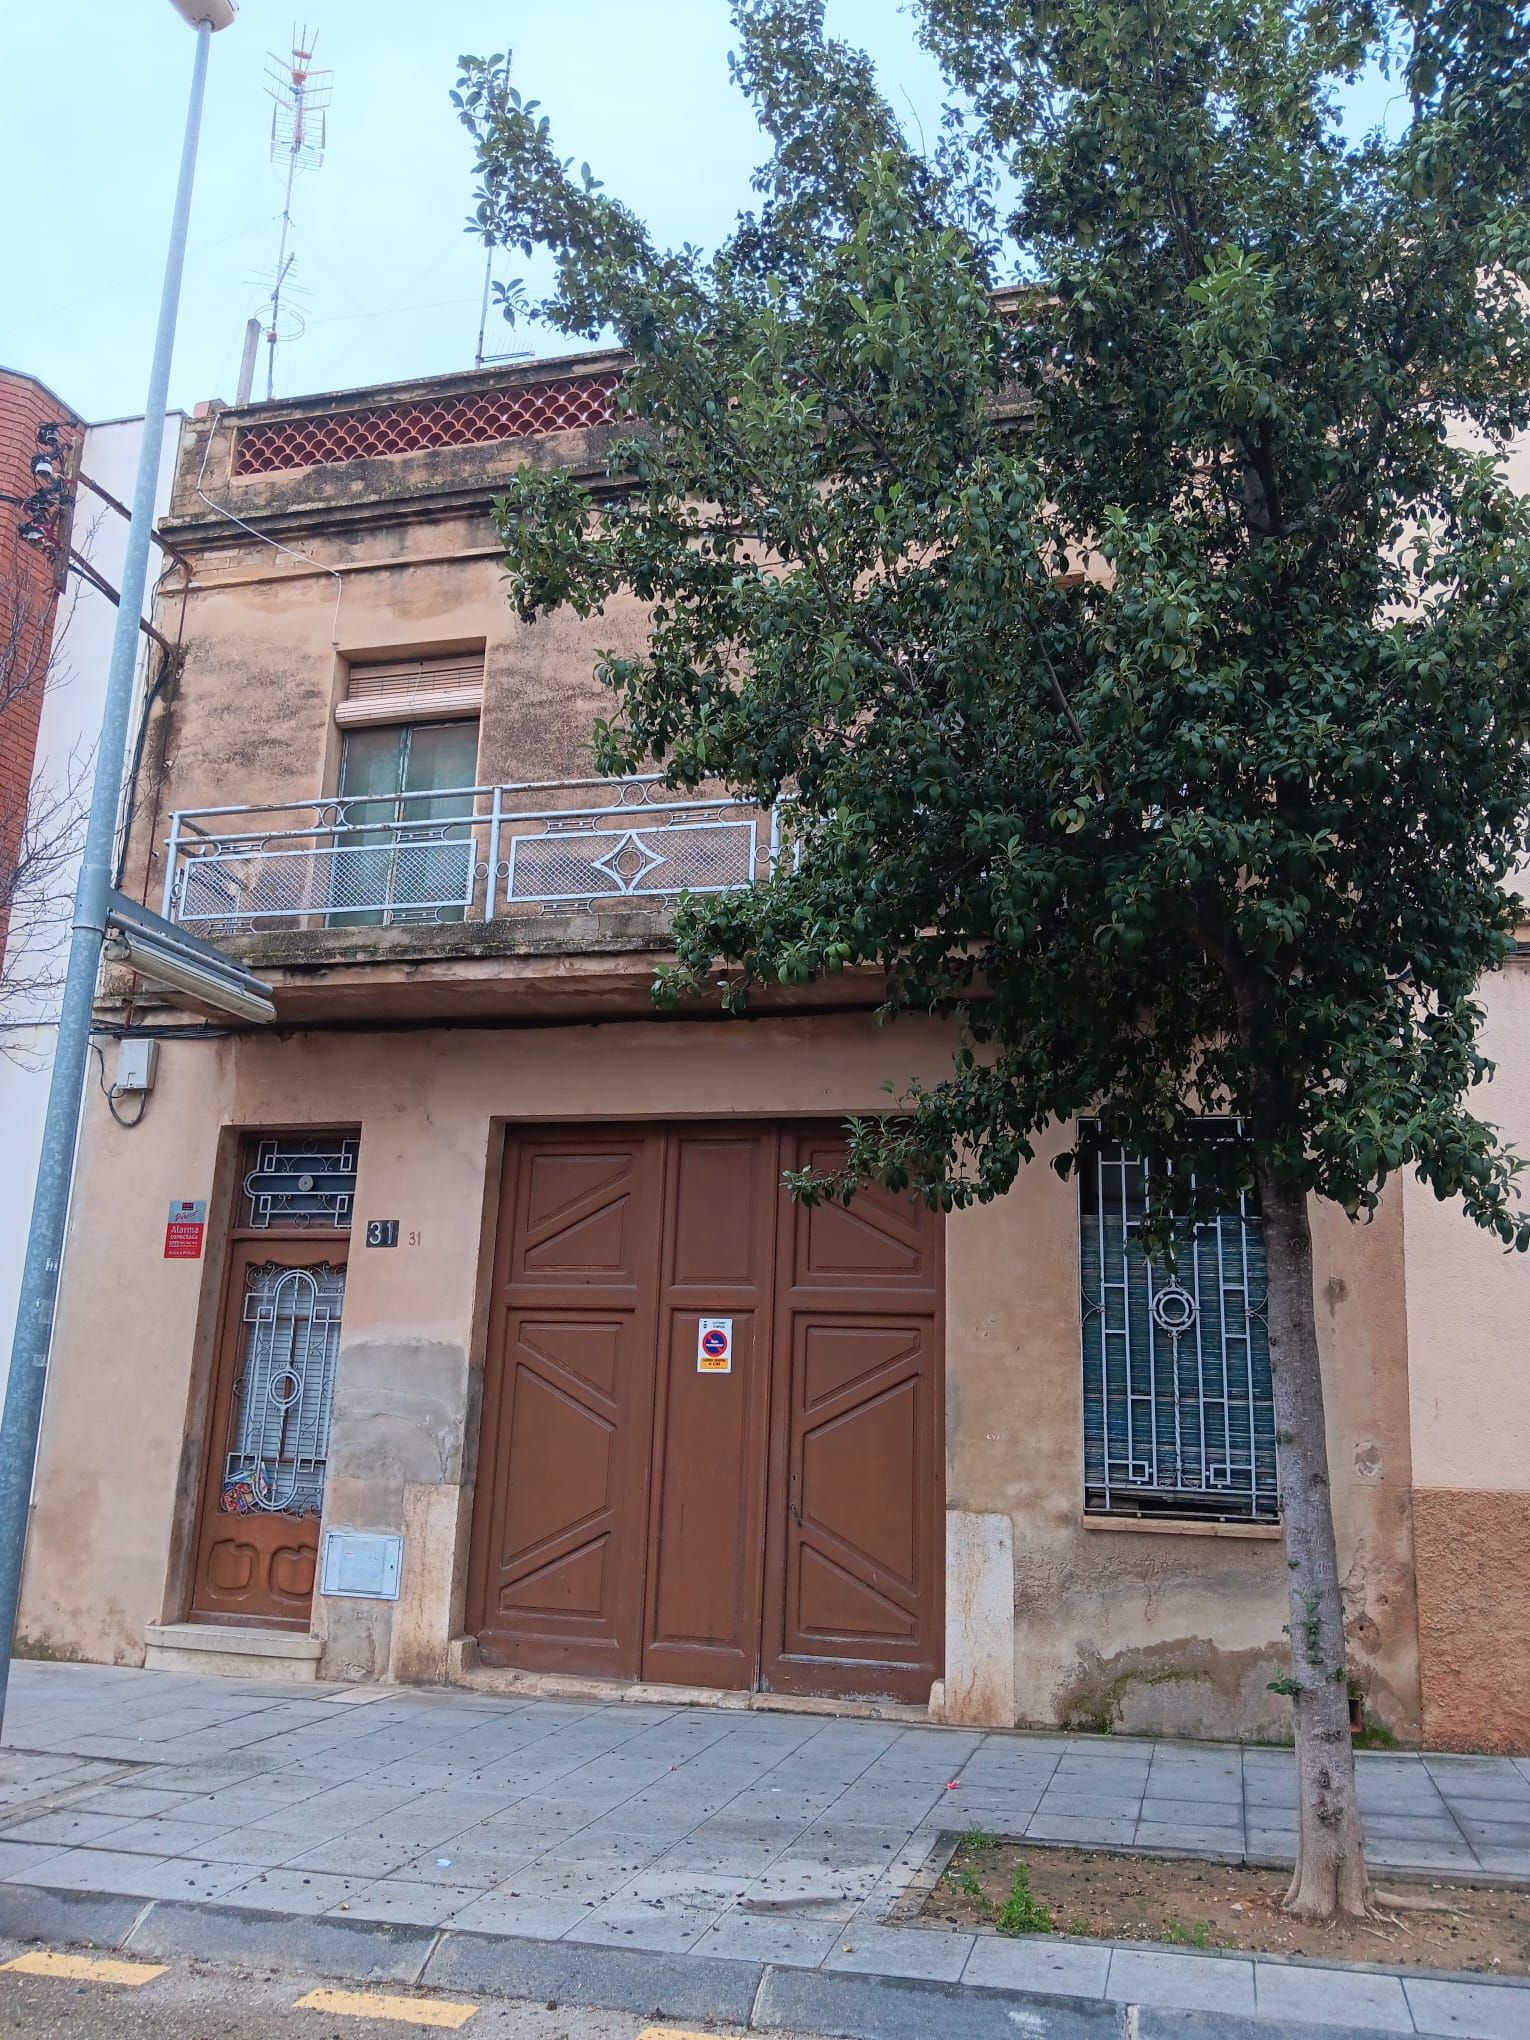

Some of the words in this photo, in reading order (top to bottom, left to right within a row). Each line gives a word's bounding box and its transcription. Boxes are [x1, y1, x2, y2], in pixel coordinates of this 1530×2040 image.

[171, 1225, 200, 1234] Alarma
[369, 1220, 394, 1245] 31
[408, 1231, 422, 1246] 31
